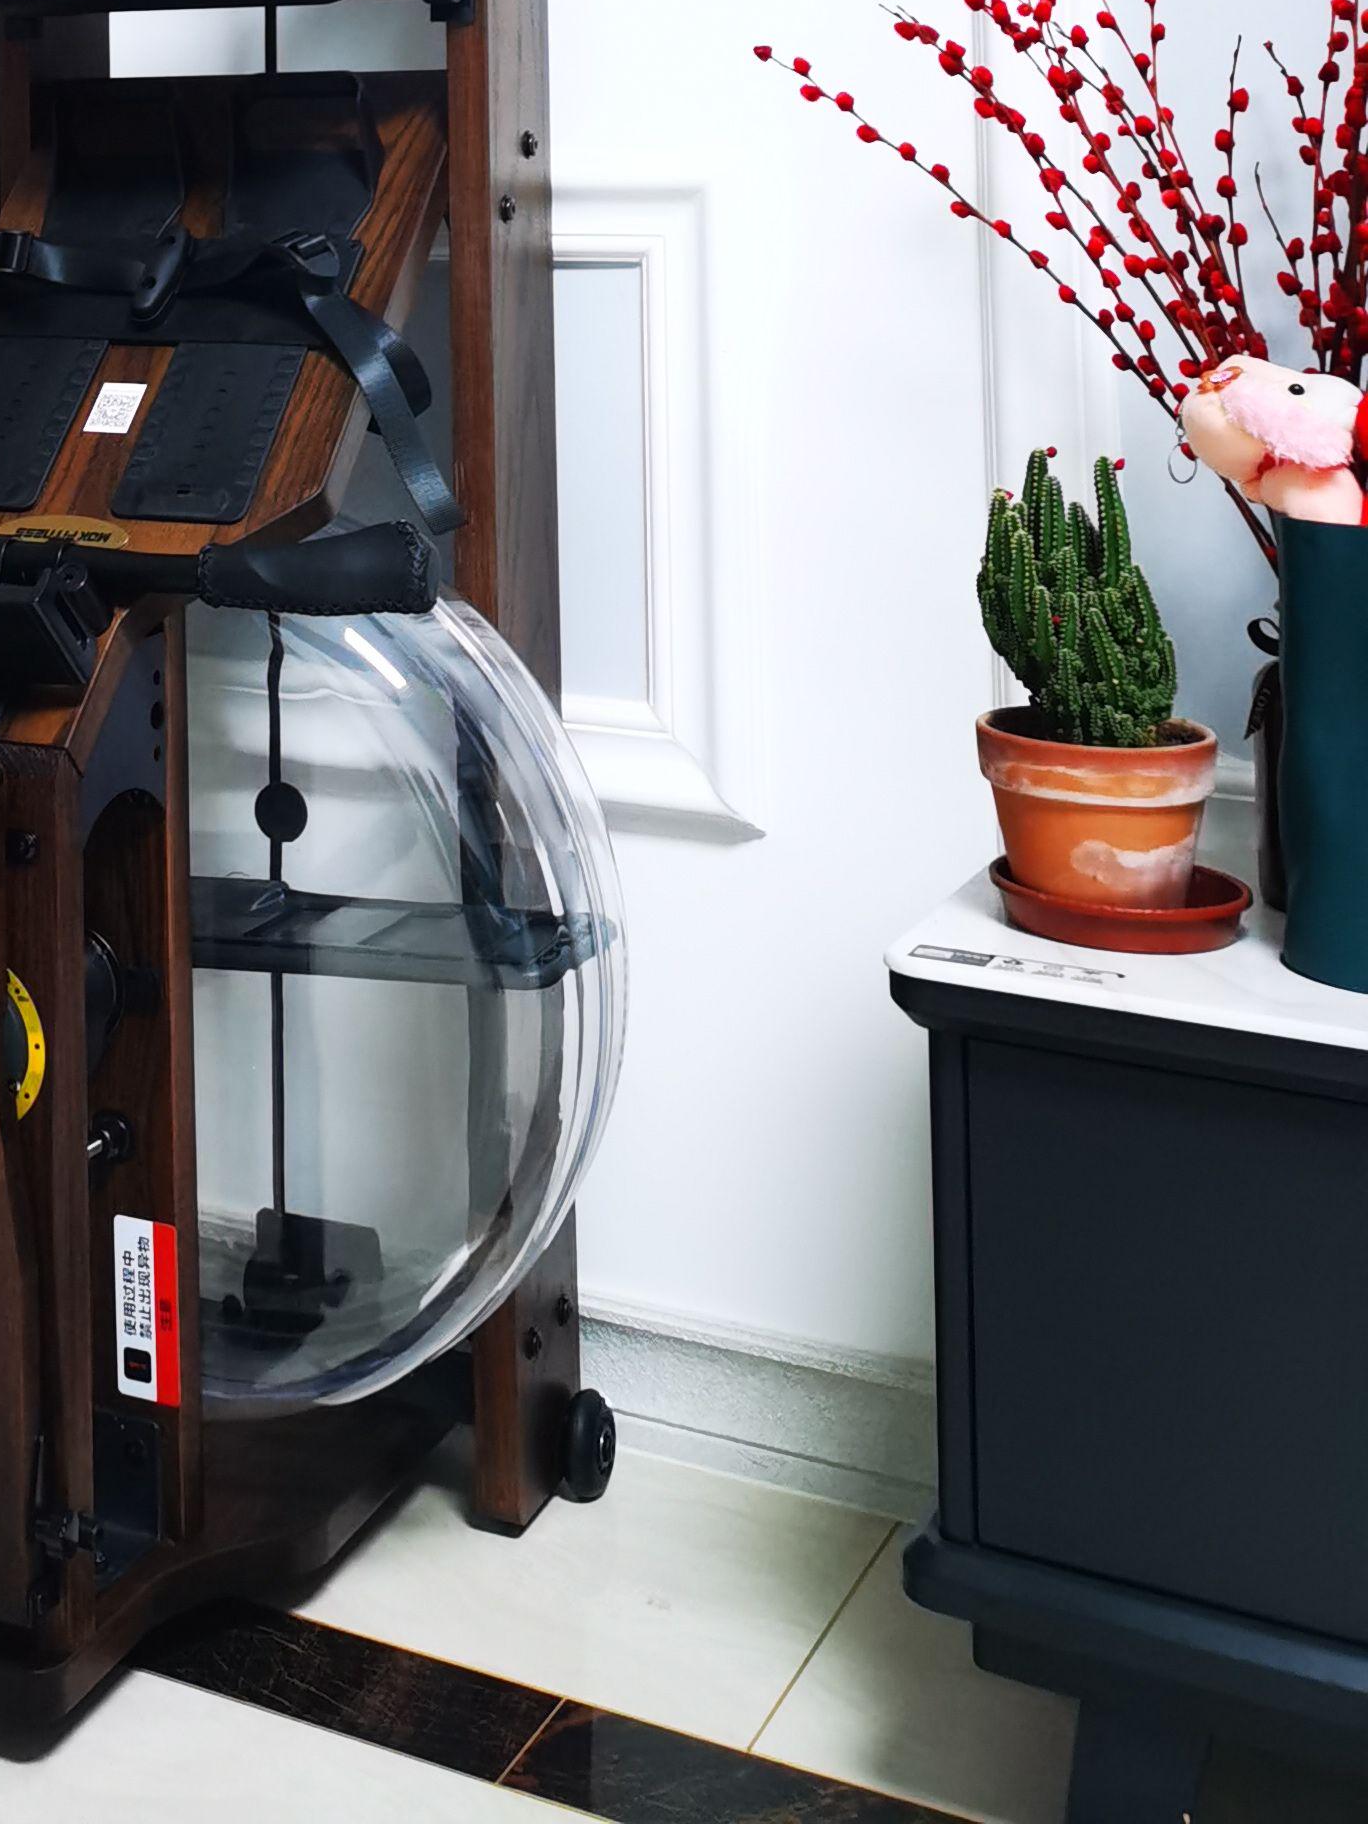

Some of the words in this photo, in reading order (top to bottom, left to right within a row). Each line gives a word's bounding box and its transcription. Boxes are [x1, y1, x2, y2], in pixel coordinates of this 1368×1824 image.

[121, 1249, 137, 1337] 使用过程中
[137, 1235, 153, 1341] 禁止出现异物
